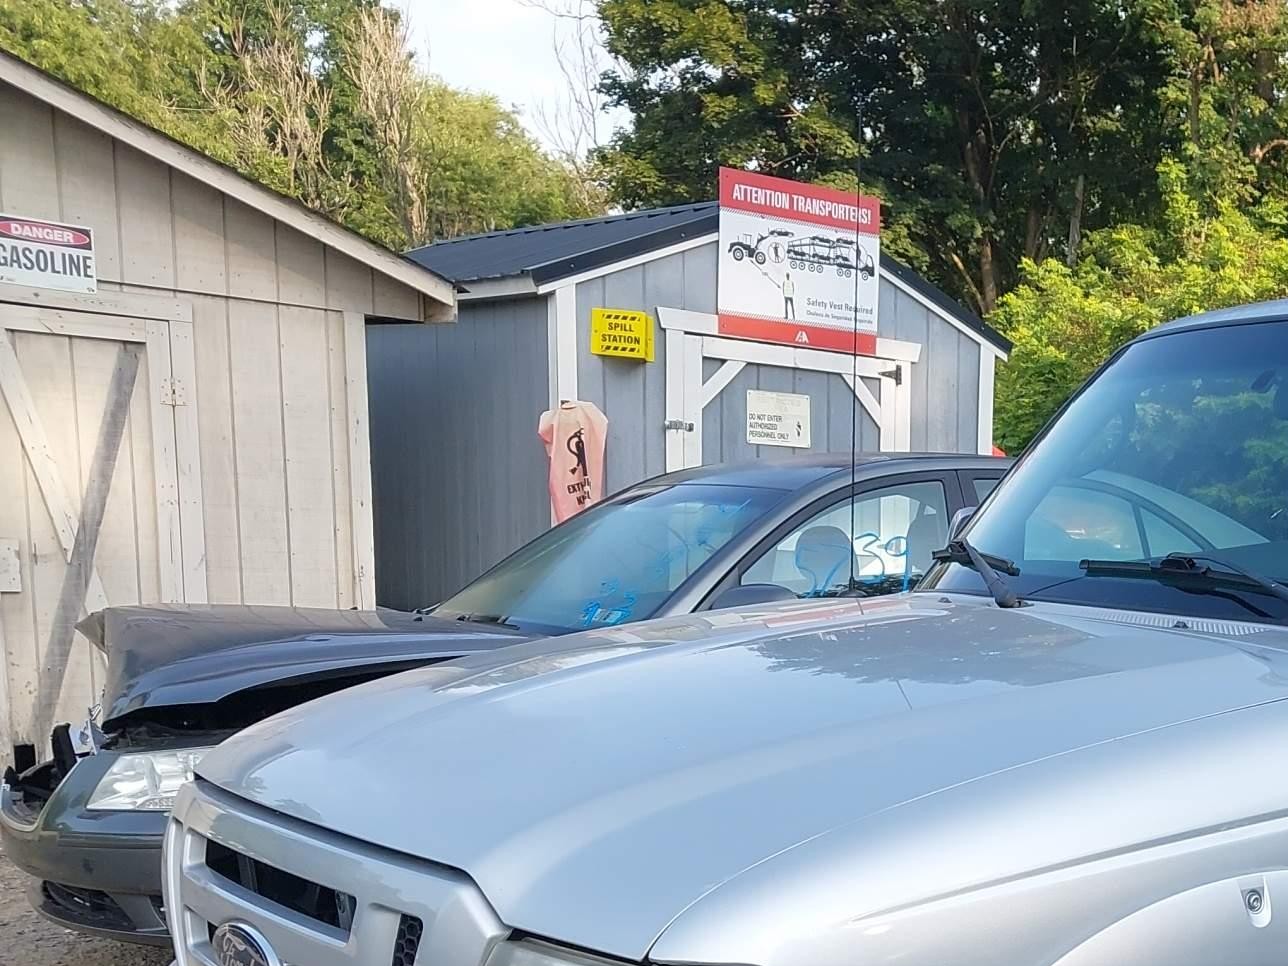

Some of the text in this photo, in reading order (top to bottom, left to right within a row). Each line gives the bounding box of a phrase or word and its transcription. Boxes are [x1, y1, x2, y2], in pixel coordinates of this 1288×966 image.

[732, 183, 872, 225] ATTENTION TRANSPORTERS!
[10, 223, 74, 243] DANGER
[0, 243, 94, 279] GASOLINE
[806, 297, 828, 309] Safety
[829, 300, 843, 310] Vest
[607, 322, 634, 333] SPILL
[601, 333, 641, 345] STATION
